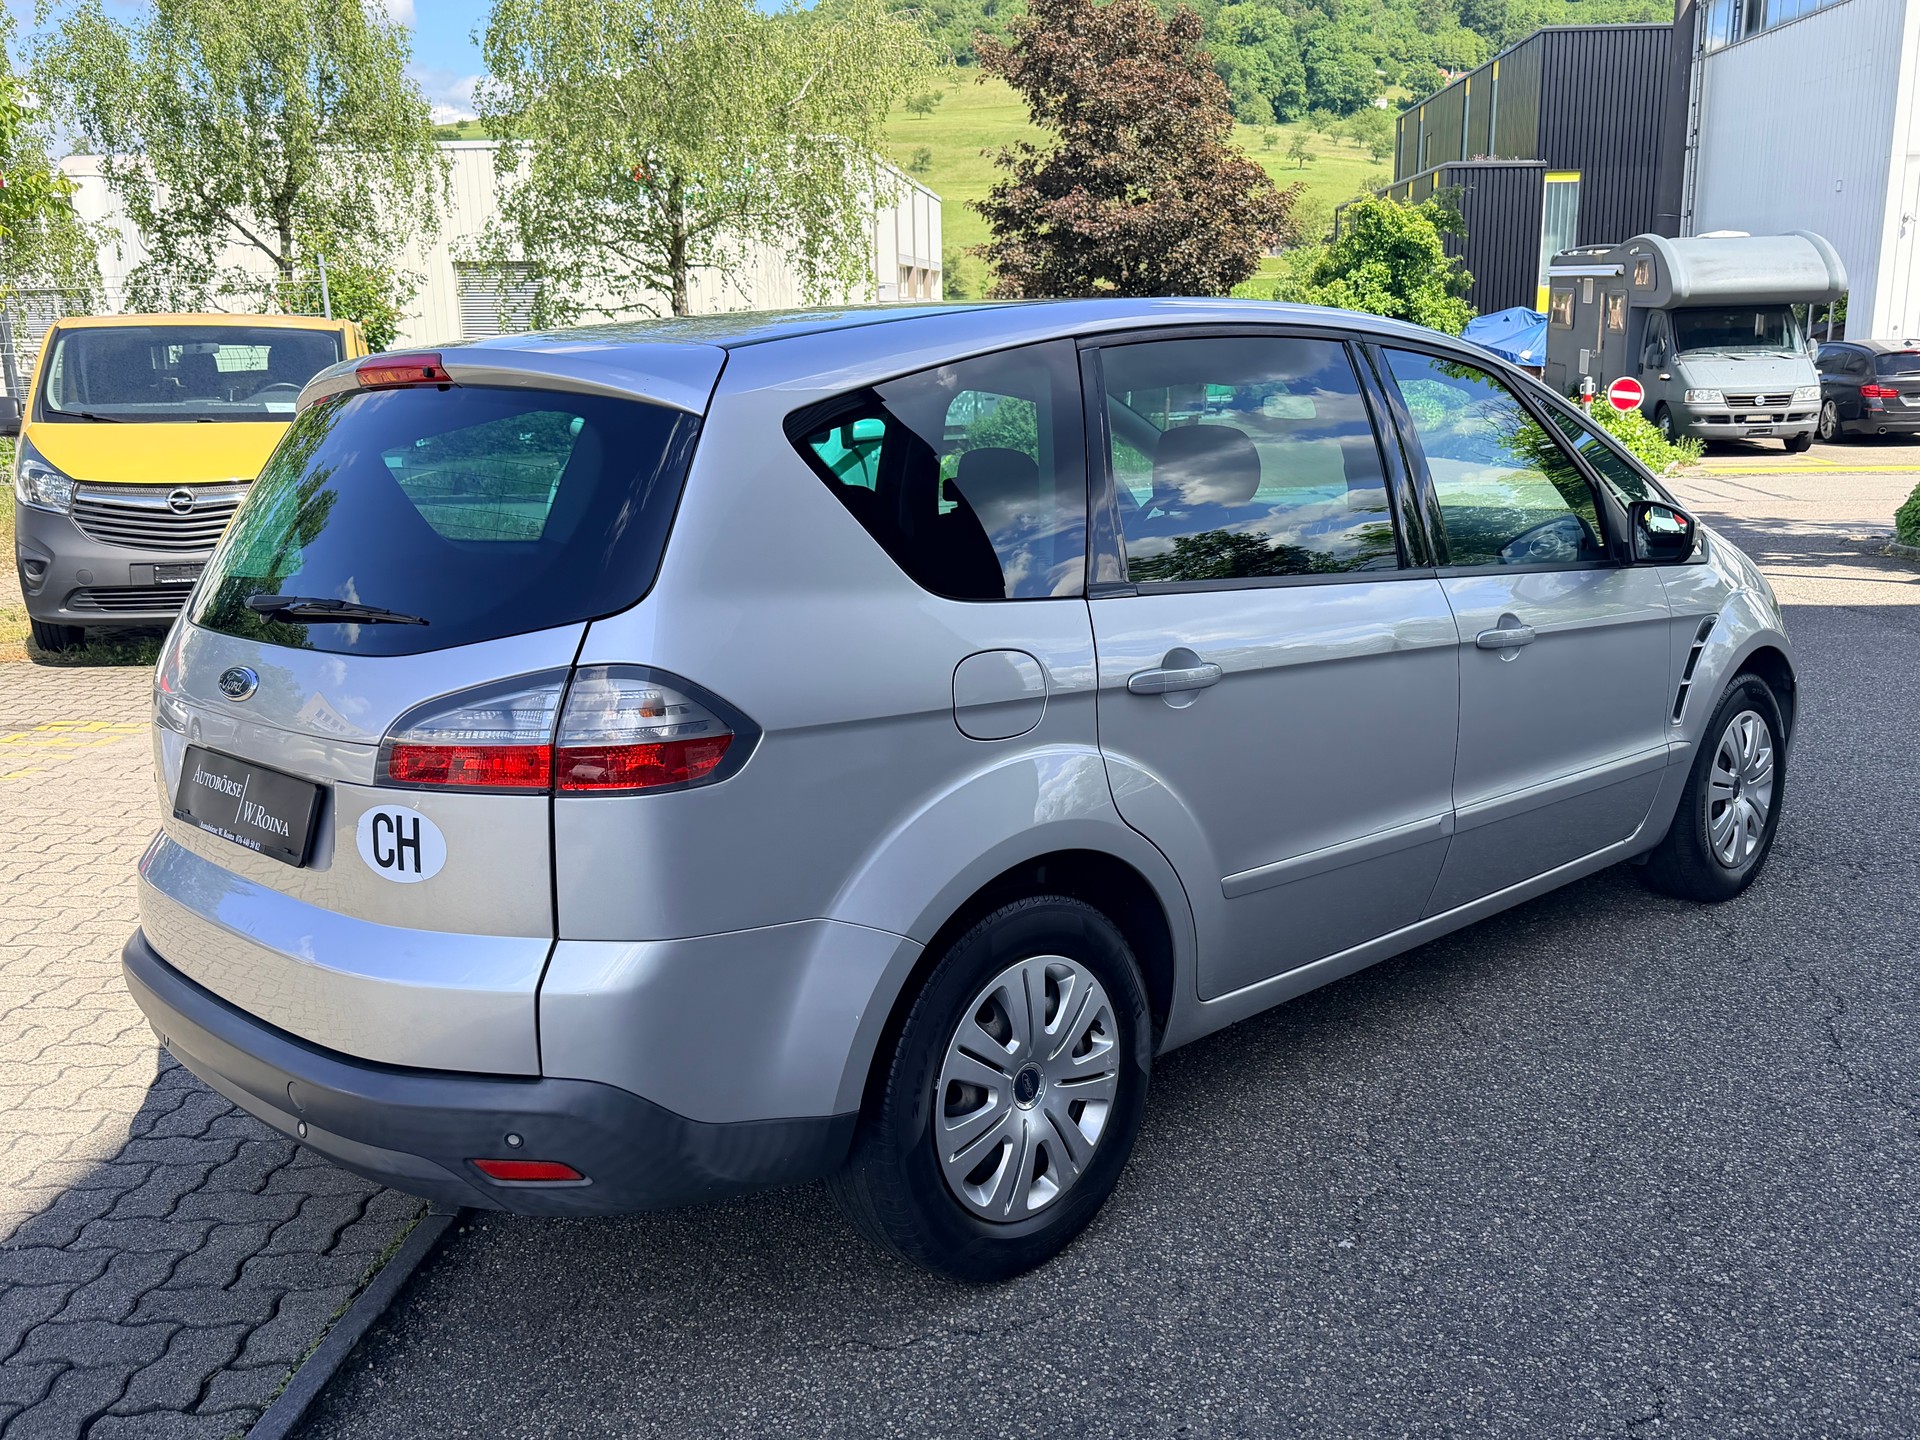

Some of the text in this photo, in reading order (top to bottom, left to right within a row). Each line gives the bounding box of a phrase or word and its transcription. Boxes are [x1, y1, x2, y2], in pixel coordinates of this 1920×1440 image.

[220, 672, 244, 693] Ford
[192, 763, 243, 798] AUTOBÖRSE
[243, 800, 290, 837] W.ROINA
[371, 812, 422, 874] CH
